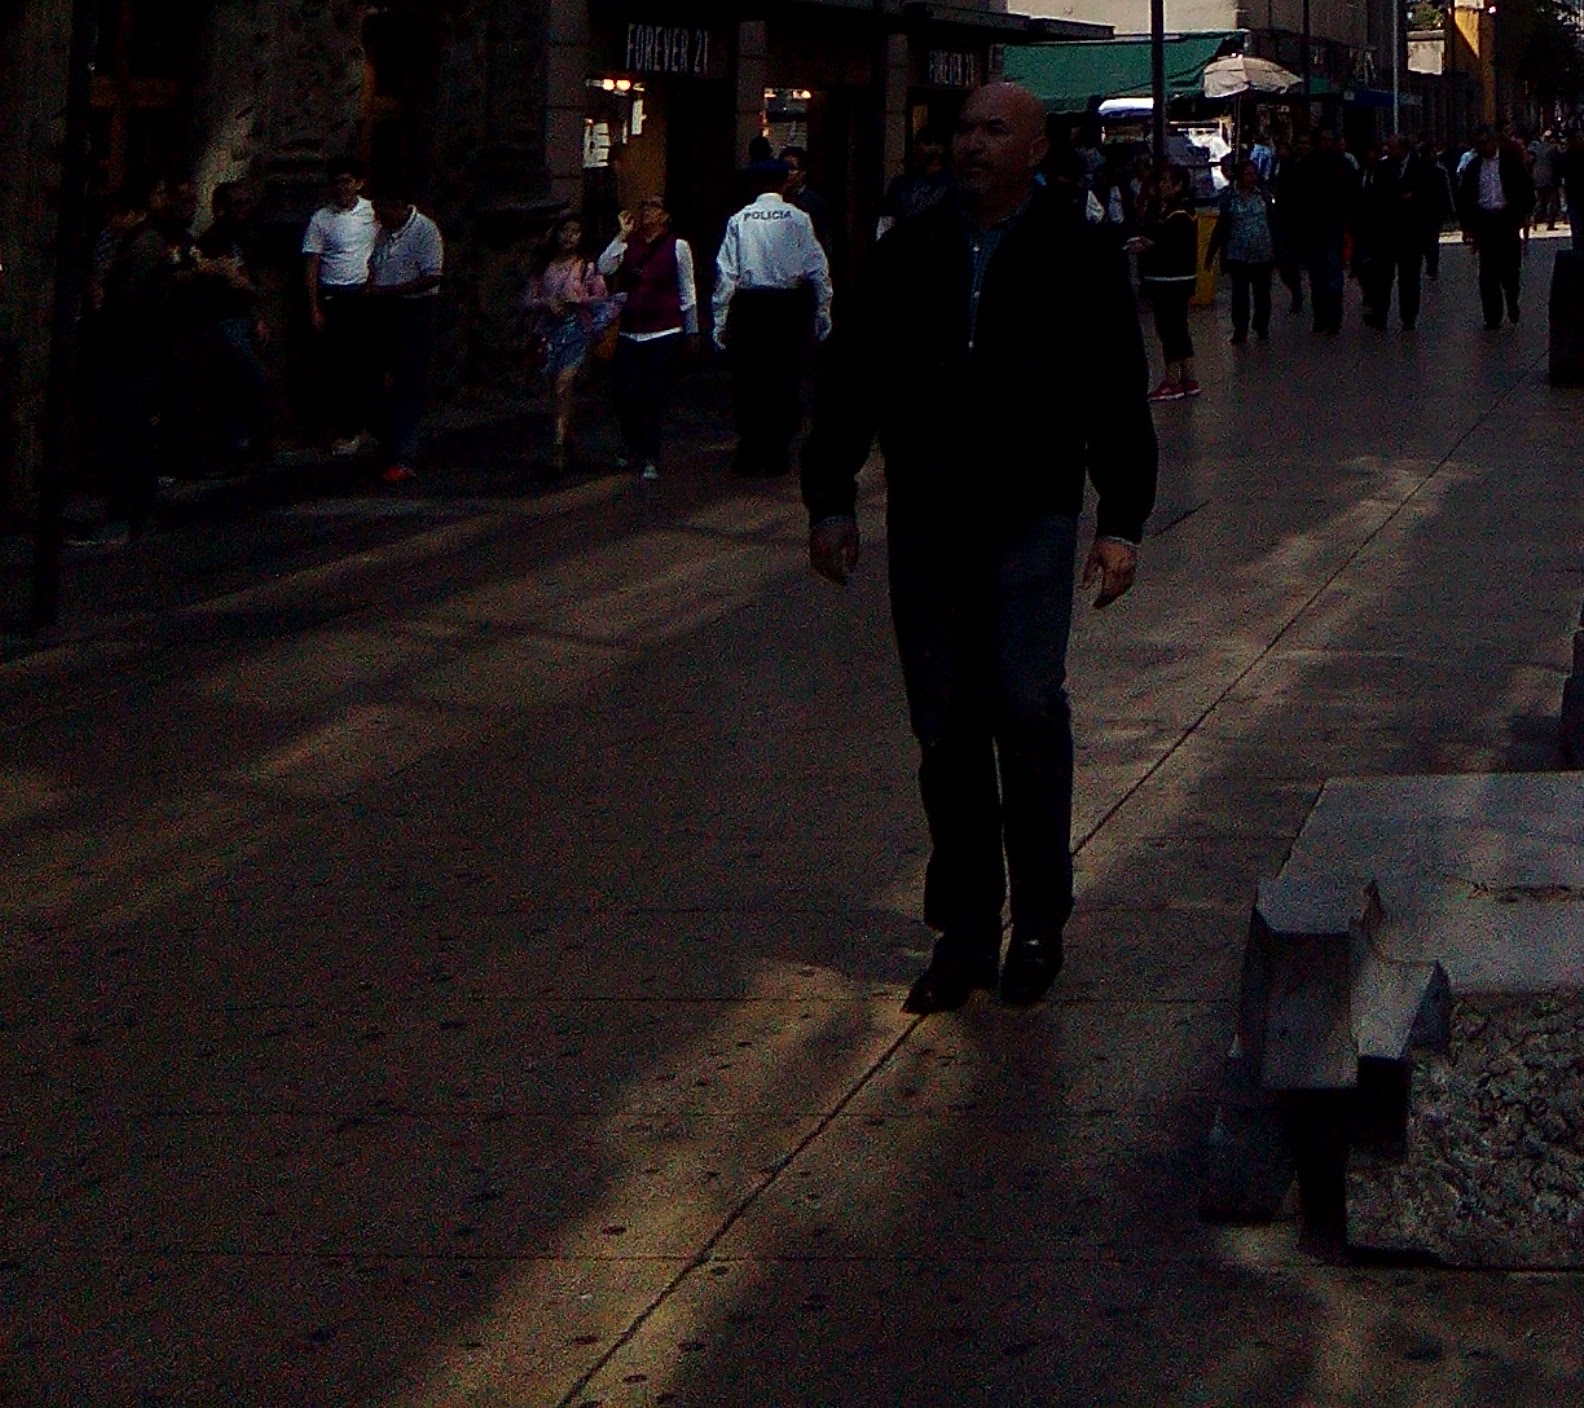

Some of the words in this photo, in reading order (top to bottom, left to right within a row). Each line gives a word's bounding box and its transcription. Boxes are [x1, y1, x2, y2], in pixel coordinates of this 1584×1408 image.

[625, 22, 689, 73] FOREVER
[694, 28, 709, 74] 21
[744, 210, 793, 222] POLICIA
